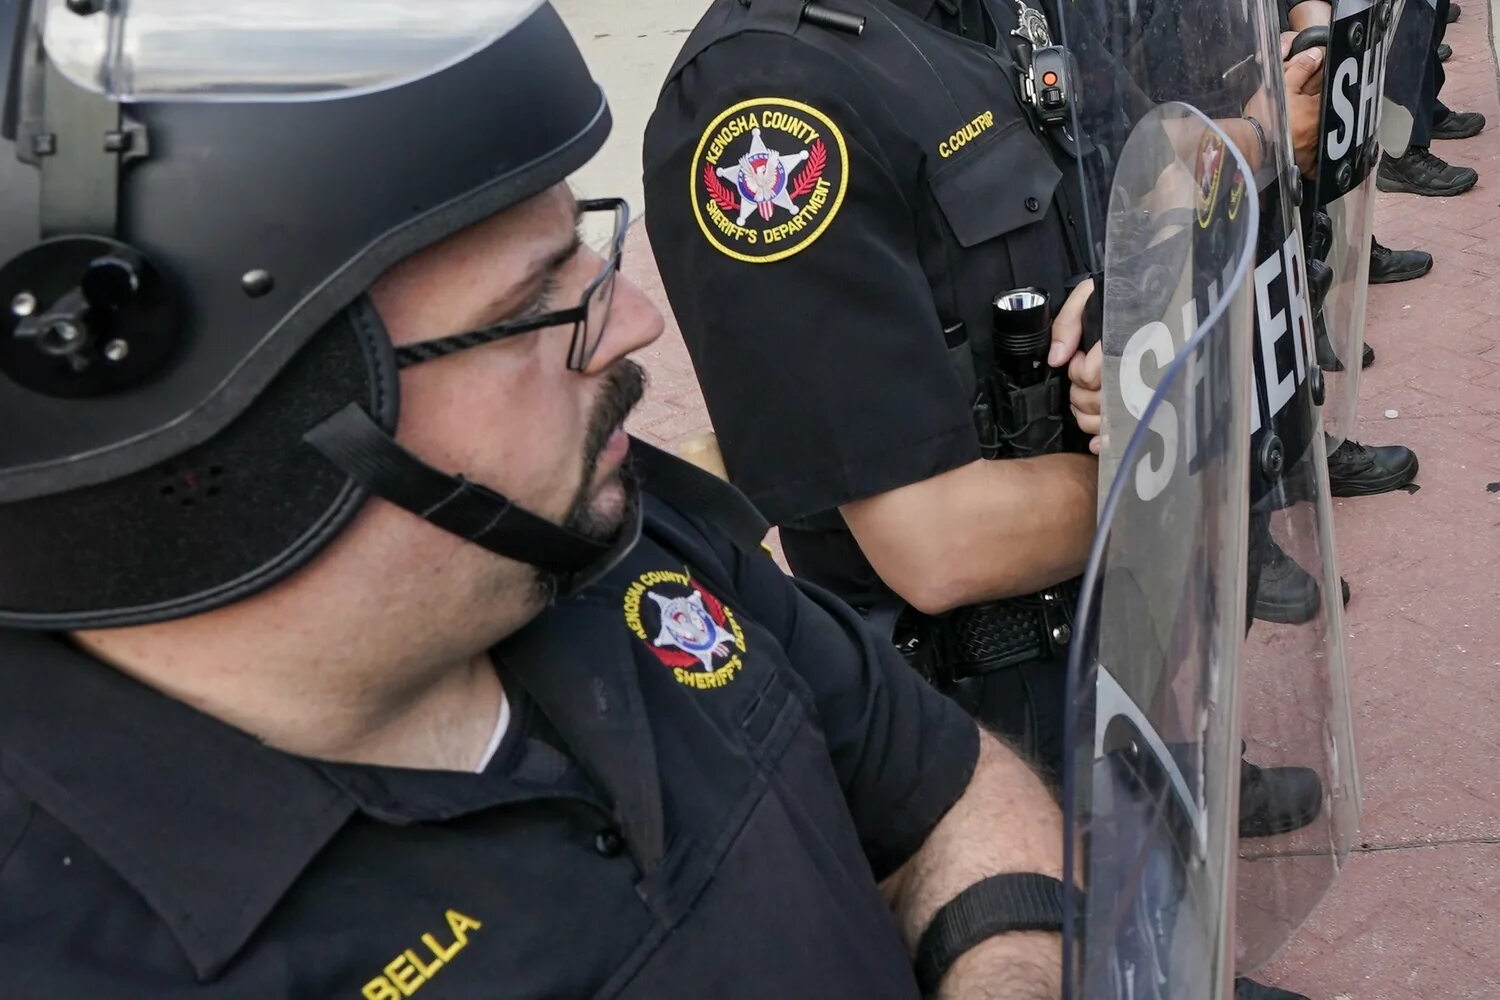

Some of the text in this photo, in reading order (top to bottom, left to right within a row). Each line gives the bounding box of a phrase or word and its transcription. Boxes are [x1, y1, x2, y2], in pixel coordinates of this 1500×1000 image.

[705, 110, 820, 165] KENOSHA COUNTY
[938, 110, 994, 158] C.COULTRIP
[706, 176, 831, 244] SHERIFF'S DEPARTMENT
[639, 570, 690, 587] COUNTY
